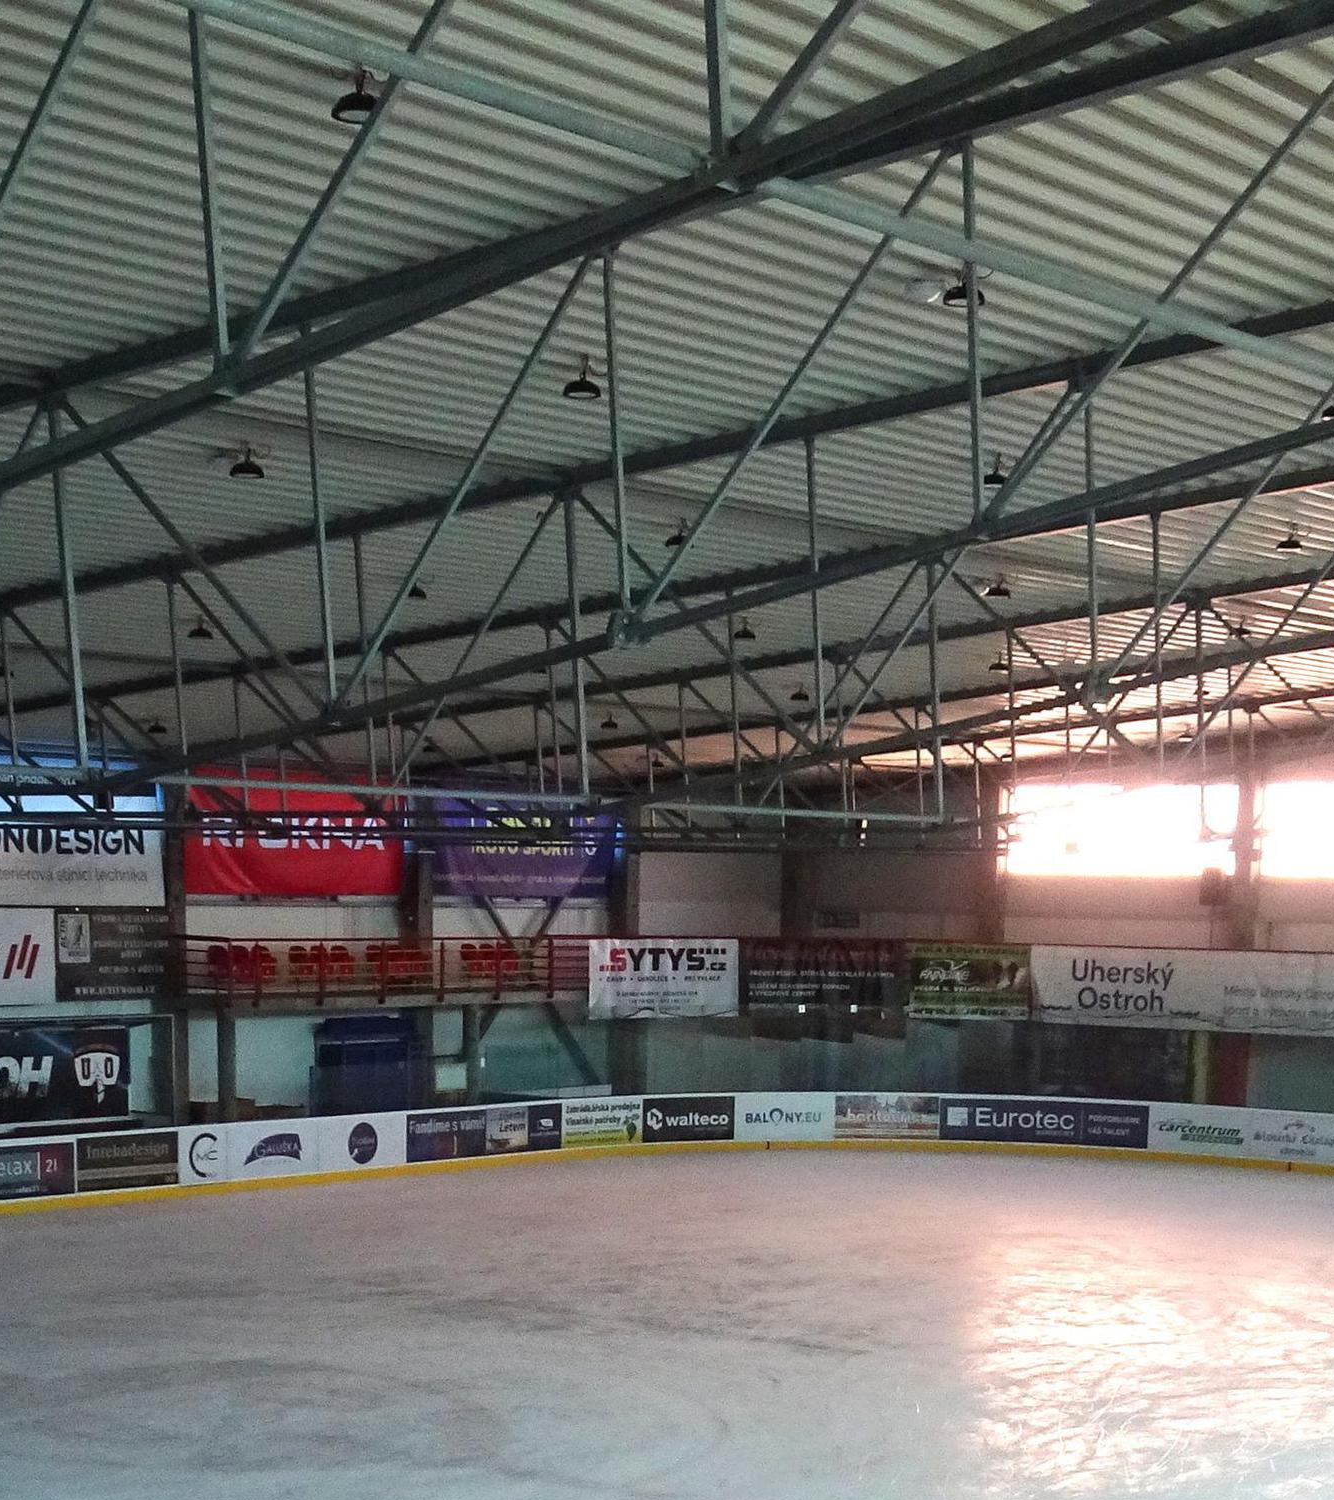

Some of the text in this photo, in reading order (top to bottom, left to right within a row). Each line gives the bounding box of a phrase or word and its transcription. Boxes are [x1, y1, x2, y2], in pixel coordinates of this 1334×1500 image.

[1070, 959, 1175, 989] Uherský
[1077, 985, 1165, 1014] Ostroh
[665, 1110, 729, 1127] walteco
[975, 1107, 1075, 1130] Eurotec
[1158, 1121, 1242, 1138] carcentrum
[45, 1159, 58, 1174] 21
